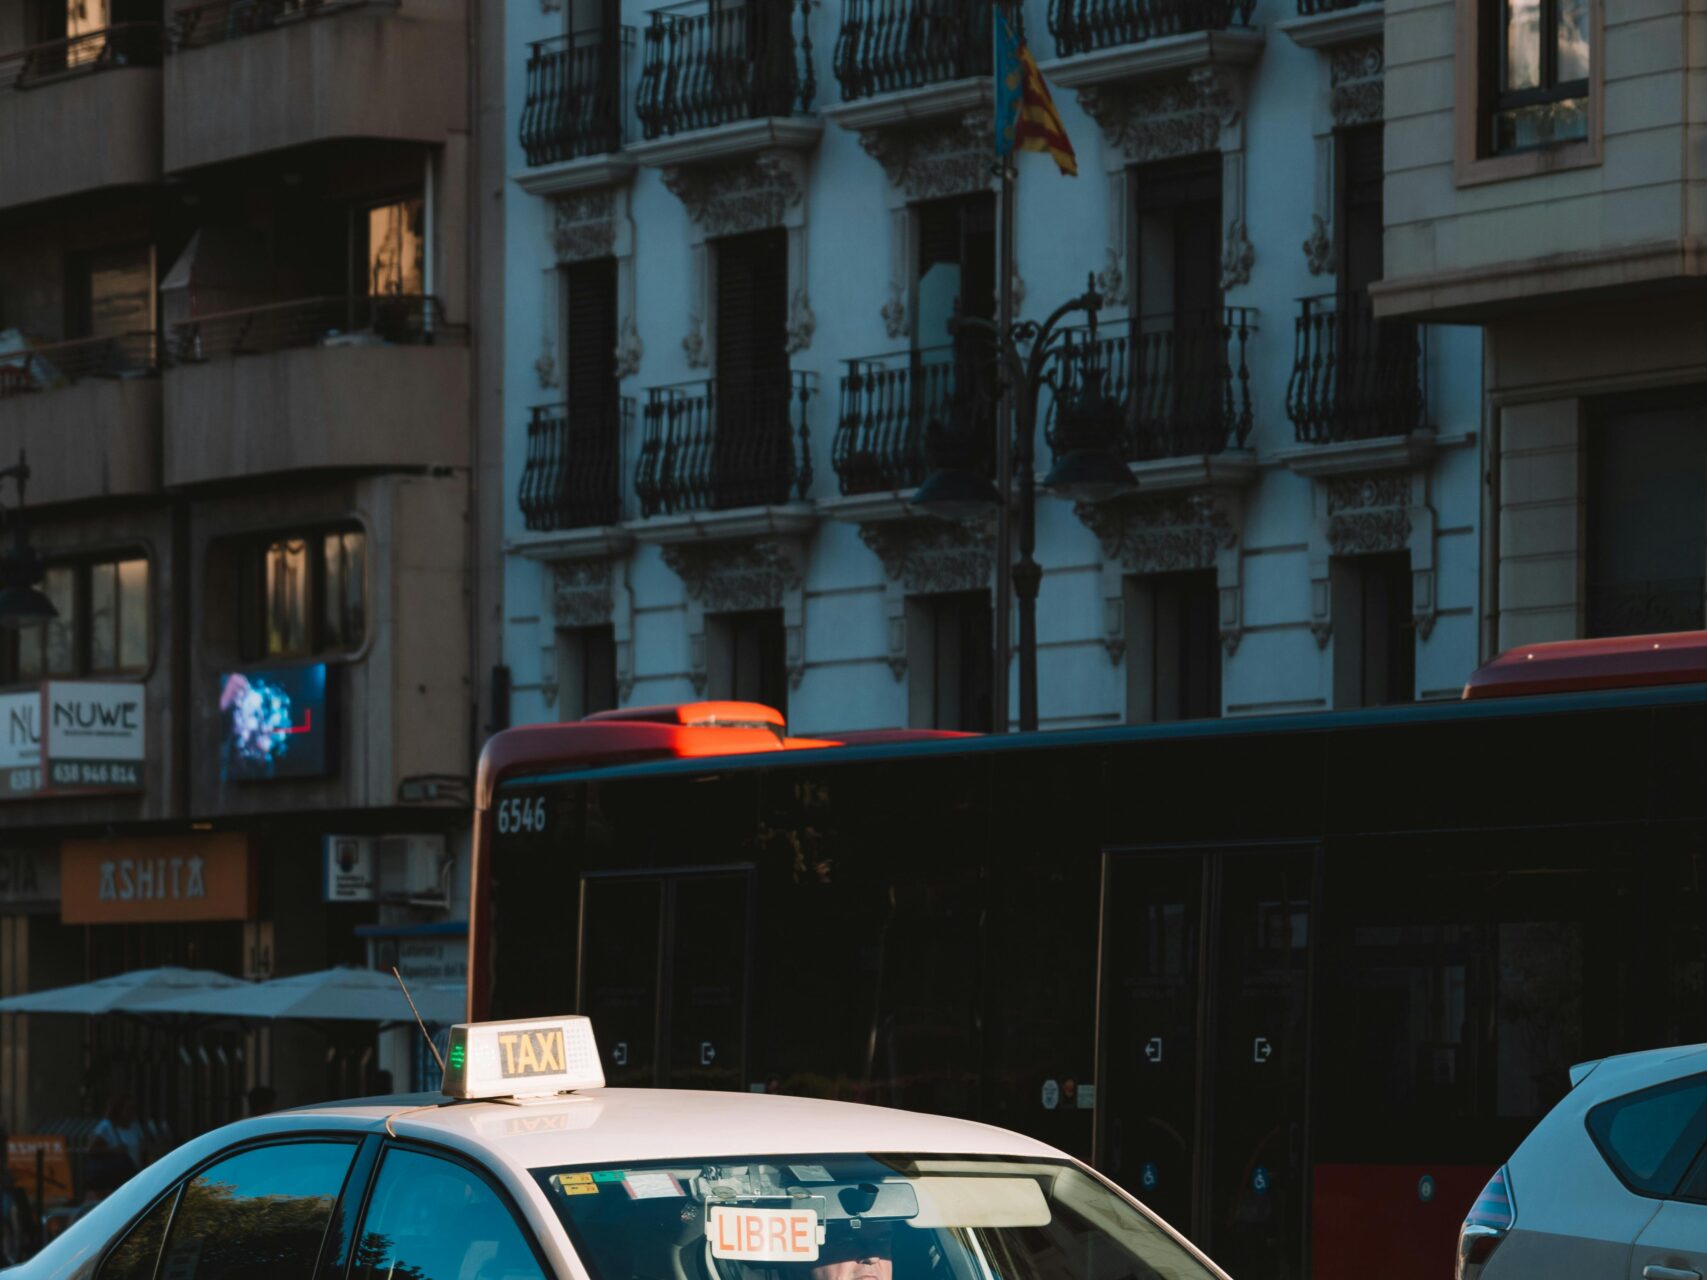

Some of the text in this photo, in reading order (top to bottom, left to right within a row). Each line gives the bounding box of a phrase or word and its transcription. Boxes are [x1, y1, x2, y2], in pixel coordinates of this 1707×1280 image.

[54, 701, 138, 728] NUWE
[498, 796, 546, 835] 6546
[99, 855, 206, 902] ASHITA
[499, 1031, 566, 1075] TAXI
[718, 1214, 810, 1253] LIBRE
